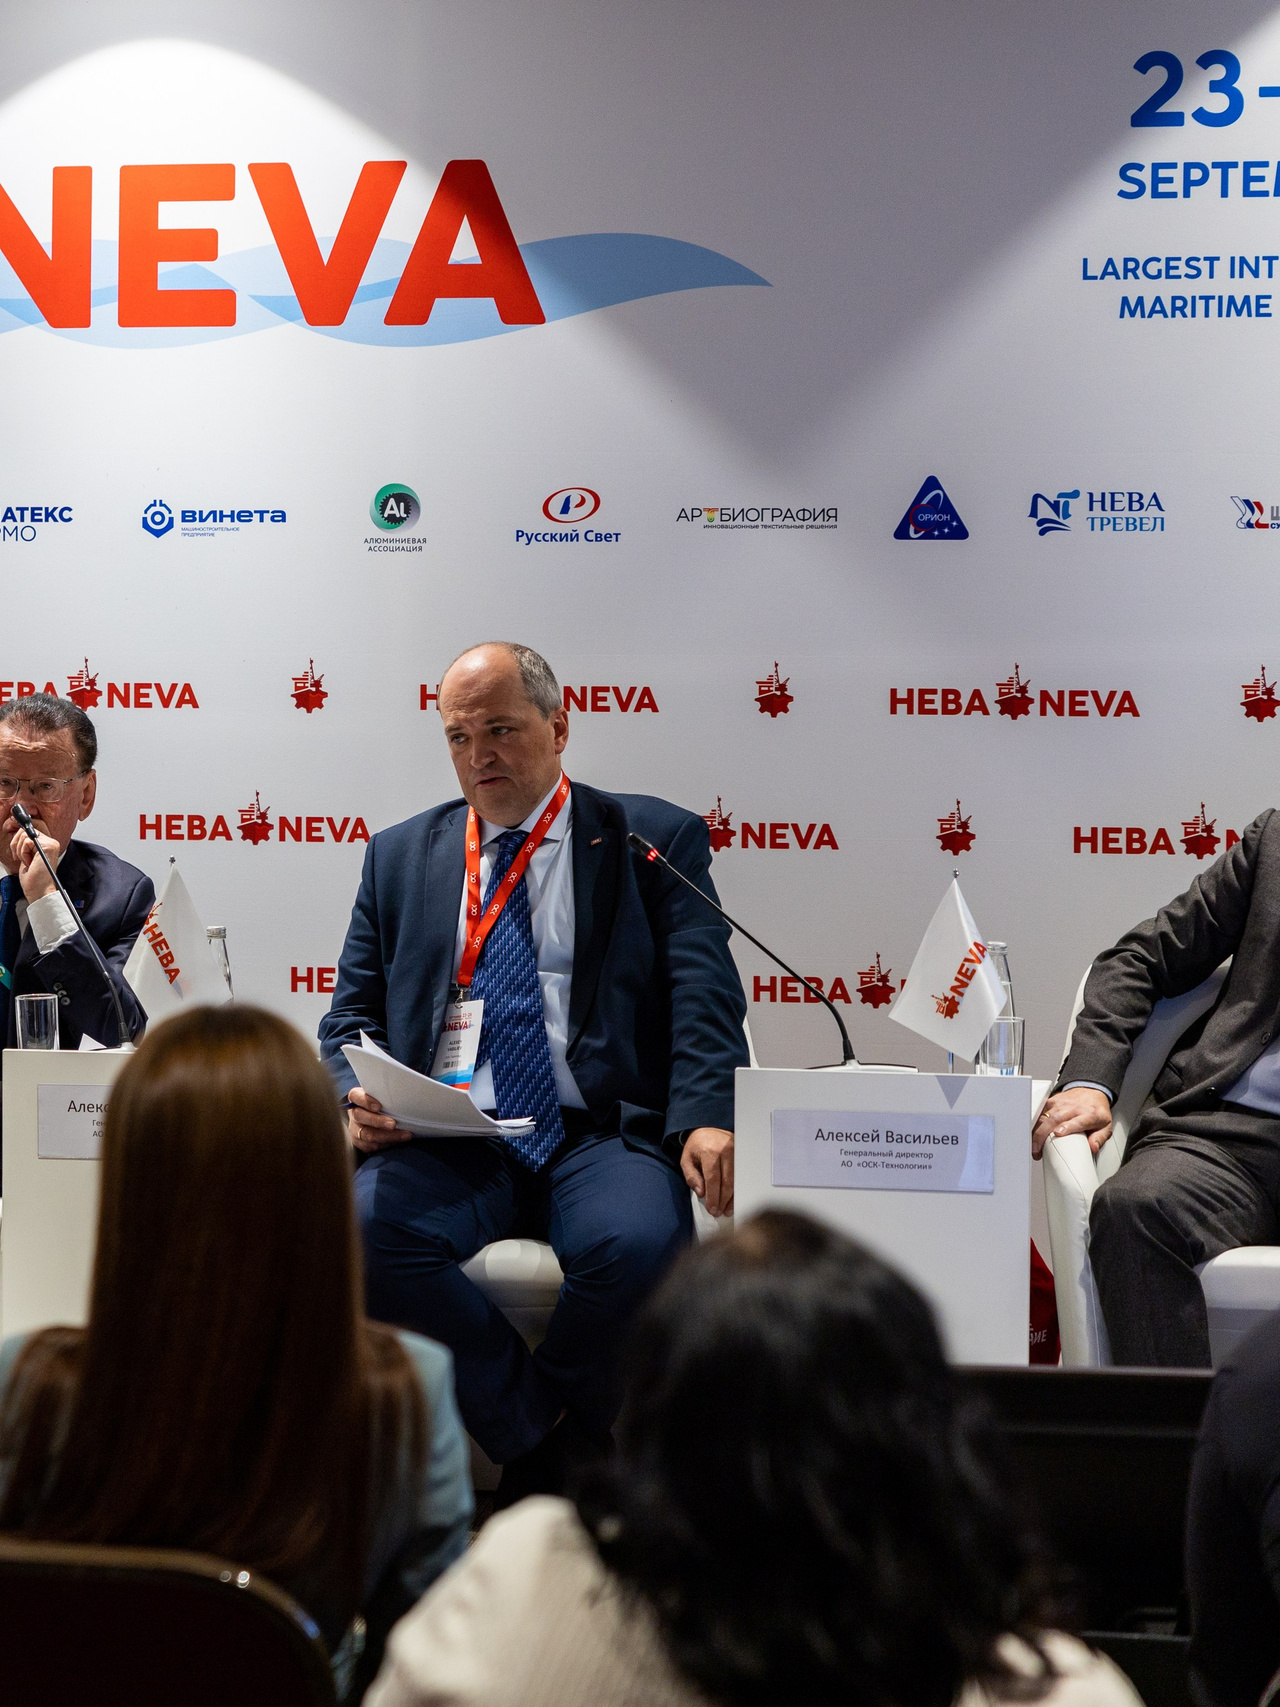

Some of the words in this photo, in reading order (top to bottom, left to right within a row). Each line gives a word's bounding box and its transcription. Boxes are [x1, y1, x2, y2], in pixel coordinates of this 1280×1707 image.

[1117, 160, 1280, 200] SEPTE
[1082, 256, 1221, 281] LARGEST
[1119, 294, 1272, 319] MARITIME
[1086, 491, 1166, 512] НЕВА
[917, 513, 951, 522] ОРИОН
[1086, 516, 1166, 532] ТРЕВЕЛ
[363, 537, 427, 545] АЛЮМИНИЕВАЯ
[367, 545, 423, 553] АССОЦИАЦИЯ
[515, 529, 580, 546] Русский
[583, 529, 622, 543] Свет
[106, 682, 200, 710] NEVA
[562, 685, 660, 713] NEVA
[889, 687, 991, 716] НЕВА
[1039, 690, 1141, 718] NEVA
[139, 813, 233, 841] НЕВА
[278, 816, 371, 844] NEVA
[741, 821, 840, 851] NEVA
[1073, 826, 1176, 856] НЕВА
[142, 922, 181, 985] НЕВА
[290, 966, 337, 994] НЕ
[949, 941, 987, 998] NEVA
[752, 975, 853, 1005] НЕВА
[814, 1128, 880, 1143] Алексей
[884, 1130, 959, 1146] Васильев
[839, 1149, 894, 1158] Генеральный
[894, 1151, 934, 1159] директор
[840, 1160, 853, 1168] АО
[856, 1161, 933, 1170] «ОСК-Технологии»
